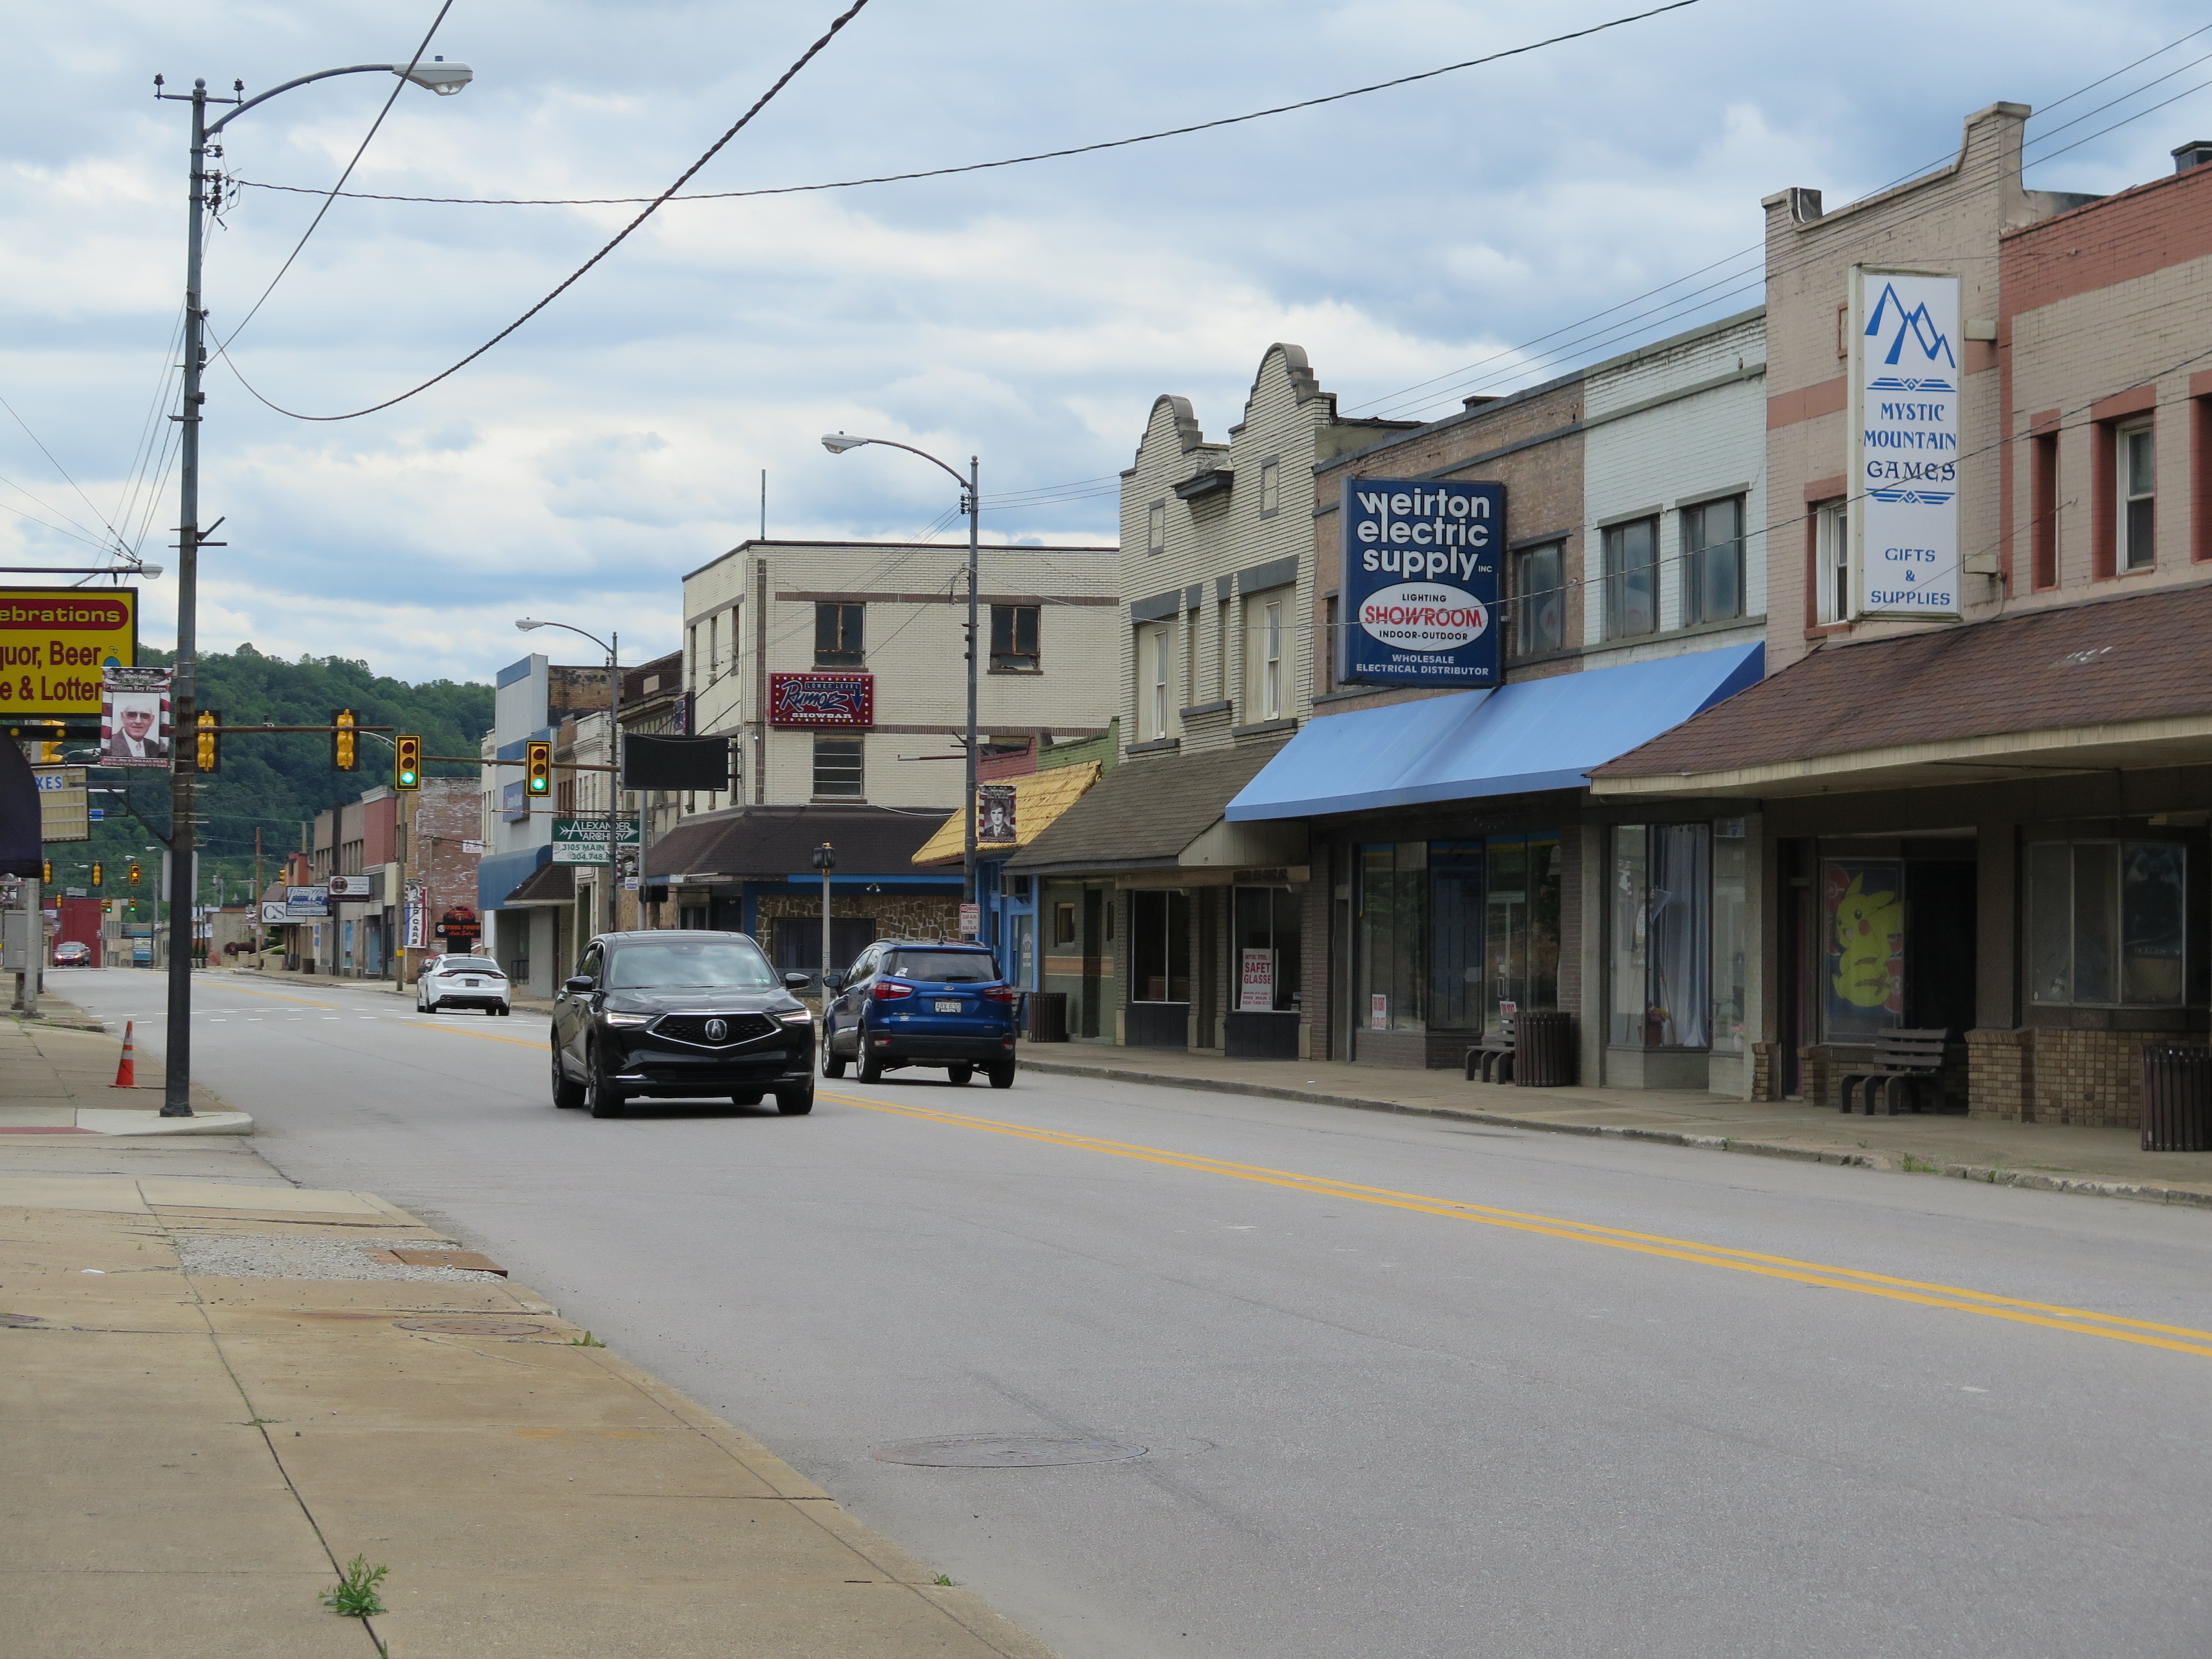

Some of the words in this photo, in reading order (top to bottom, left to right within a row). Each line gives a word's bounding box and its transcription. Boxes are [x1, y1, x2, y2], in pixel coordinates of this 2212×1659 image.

[1881, 403, 1944, 421] MYSTIC
[1864, 430, 1956, 450] MOUNTAIN
[1867, 461, 1955, 483] GAMES
[1357, 488, 1490, 519] weirton
[1357, 518, 1489, 546] electric
[1363, 546, 1478, 581] supply
[1885, 548, 1936, 562] GIFTS
[1906, 570, 1916, 581] &
[1402, 593, 1447, 602] LIGHTING
[1871, 591, 1950, 605] SUPPLIES
[1365, 606, 1483, 627] SHOWROOM
[1379, 630, 1468, 640] INDOOR-OUTDOOR
[0, 646, 41, 671] uor,
[50, 641, 101, 665] Beer
[1392, 654, 1454, 664] WHOLESALE
[1357, 663, 1417, 674] ELECTRICAL
[1421, 665, 1489, 675] DISTRIBUTOR
[19, 676, 34, 701] &
[41, 676, 102, 701] Lotter
[780, 680, 849, 712] Rumorz
[1245, 962, 1270, 973] SAFET
[1244, 974, 1271, 984] GLASSE
